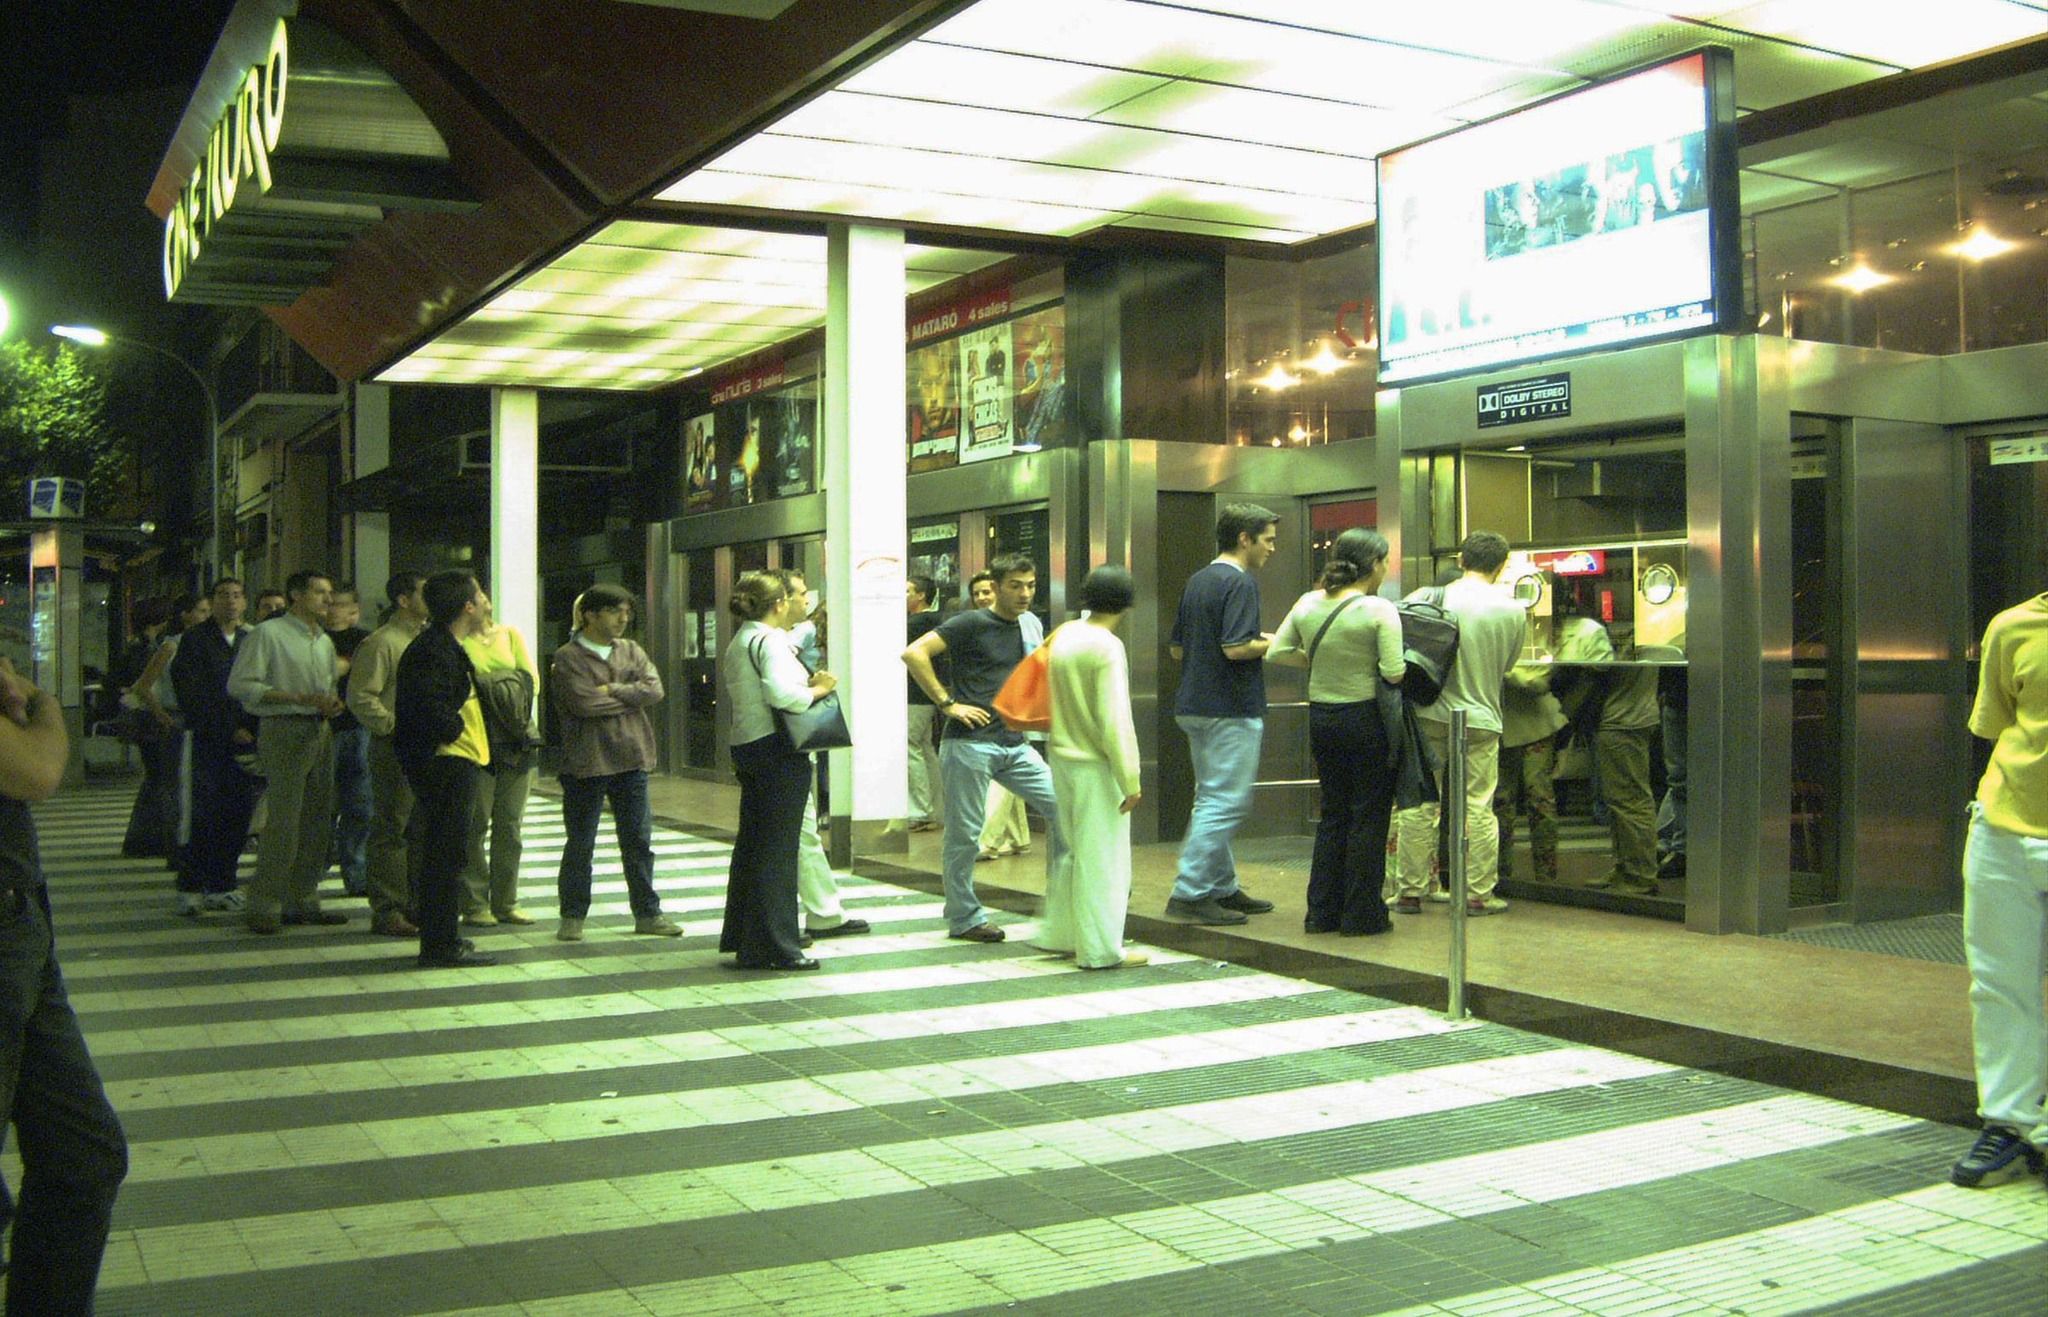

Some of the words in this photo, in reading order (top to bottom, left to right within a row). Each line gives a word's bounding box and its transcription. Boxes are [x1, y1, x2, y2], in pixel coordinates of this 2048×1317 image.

[968, 307, 976, 321] 4
[977, 301, 1008, 319] sales
[1503, 390, 1531, 405] DOLBY
[1532, 386, 1564, 400] STEREO
[1500, 402, 1568, 419] DIGITAL
